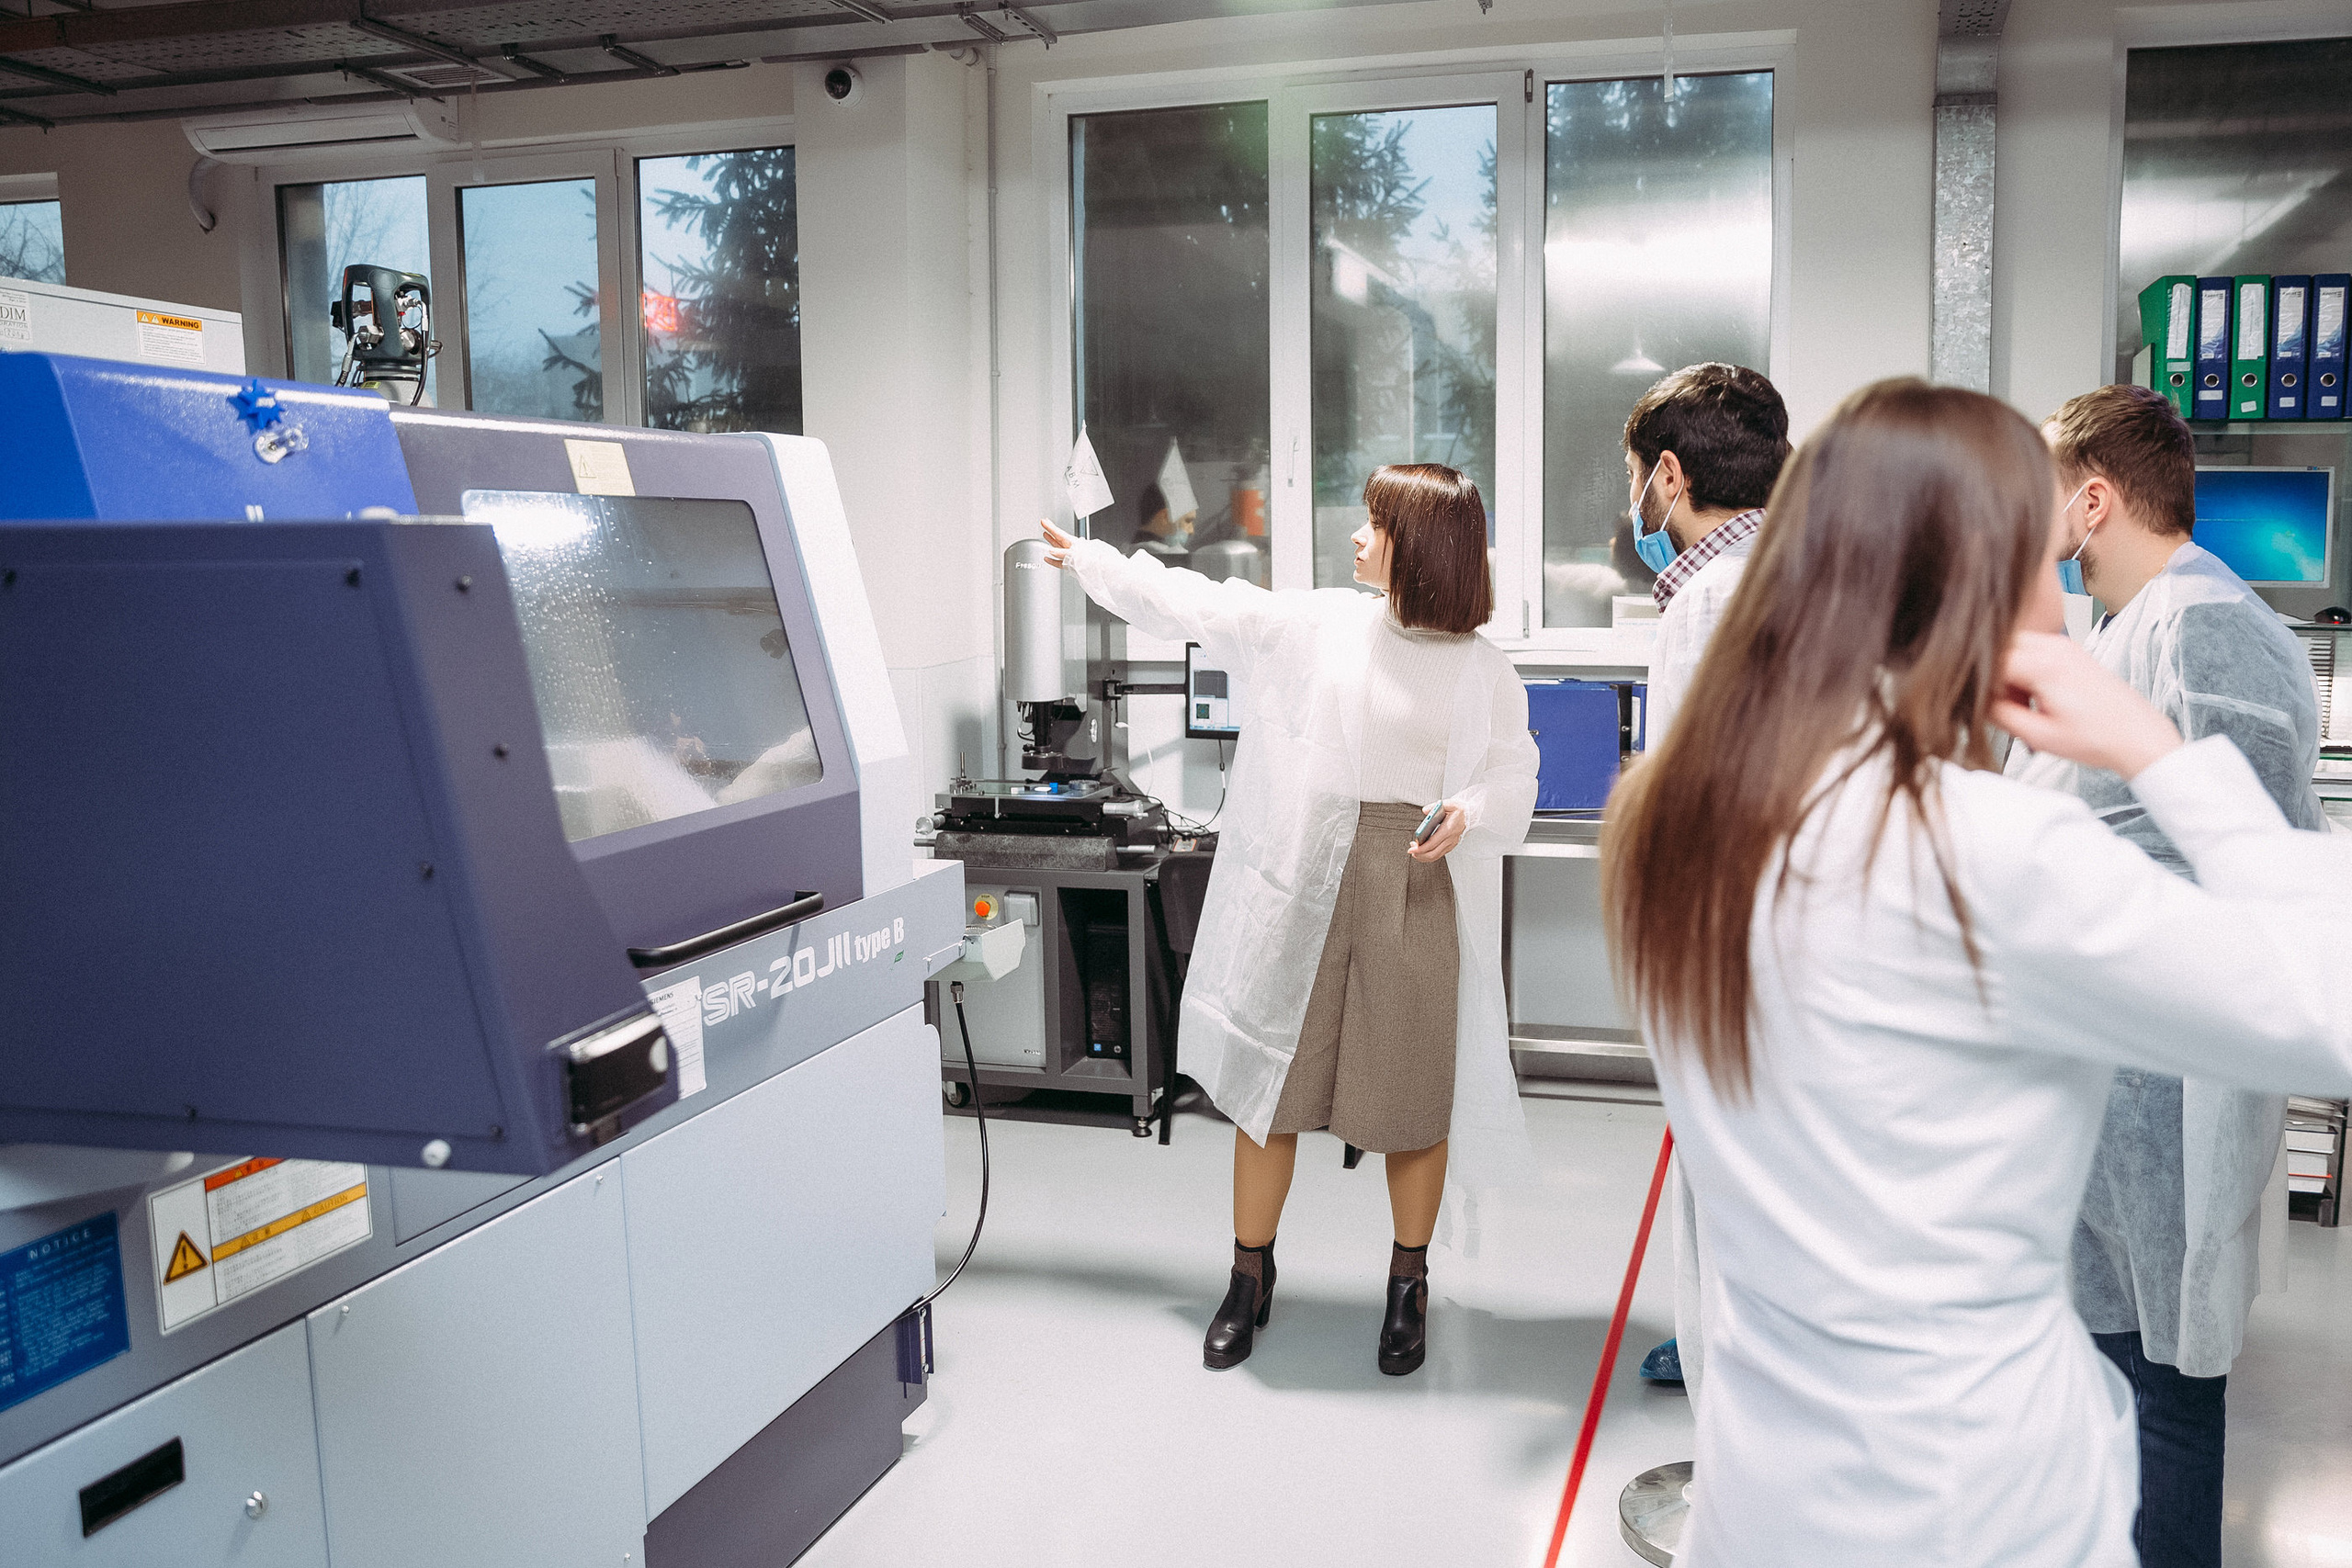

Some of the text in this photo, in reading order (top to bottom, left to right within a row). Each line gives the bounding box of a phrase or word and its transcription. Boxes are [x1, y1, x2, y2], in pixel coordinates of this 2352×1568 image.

[161, 316, 199, 329] WARNING
[854, 926, 891, 964] type
[893, 917, 905, 945] B
[650, 992, 674, 1006] SIEMENS
[313, 1194, 349, 1214] CAUTION
[28, 1227, 92, 1261] NOTICE
